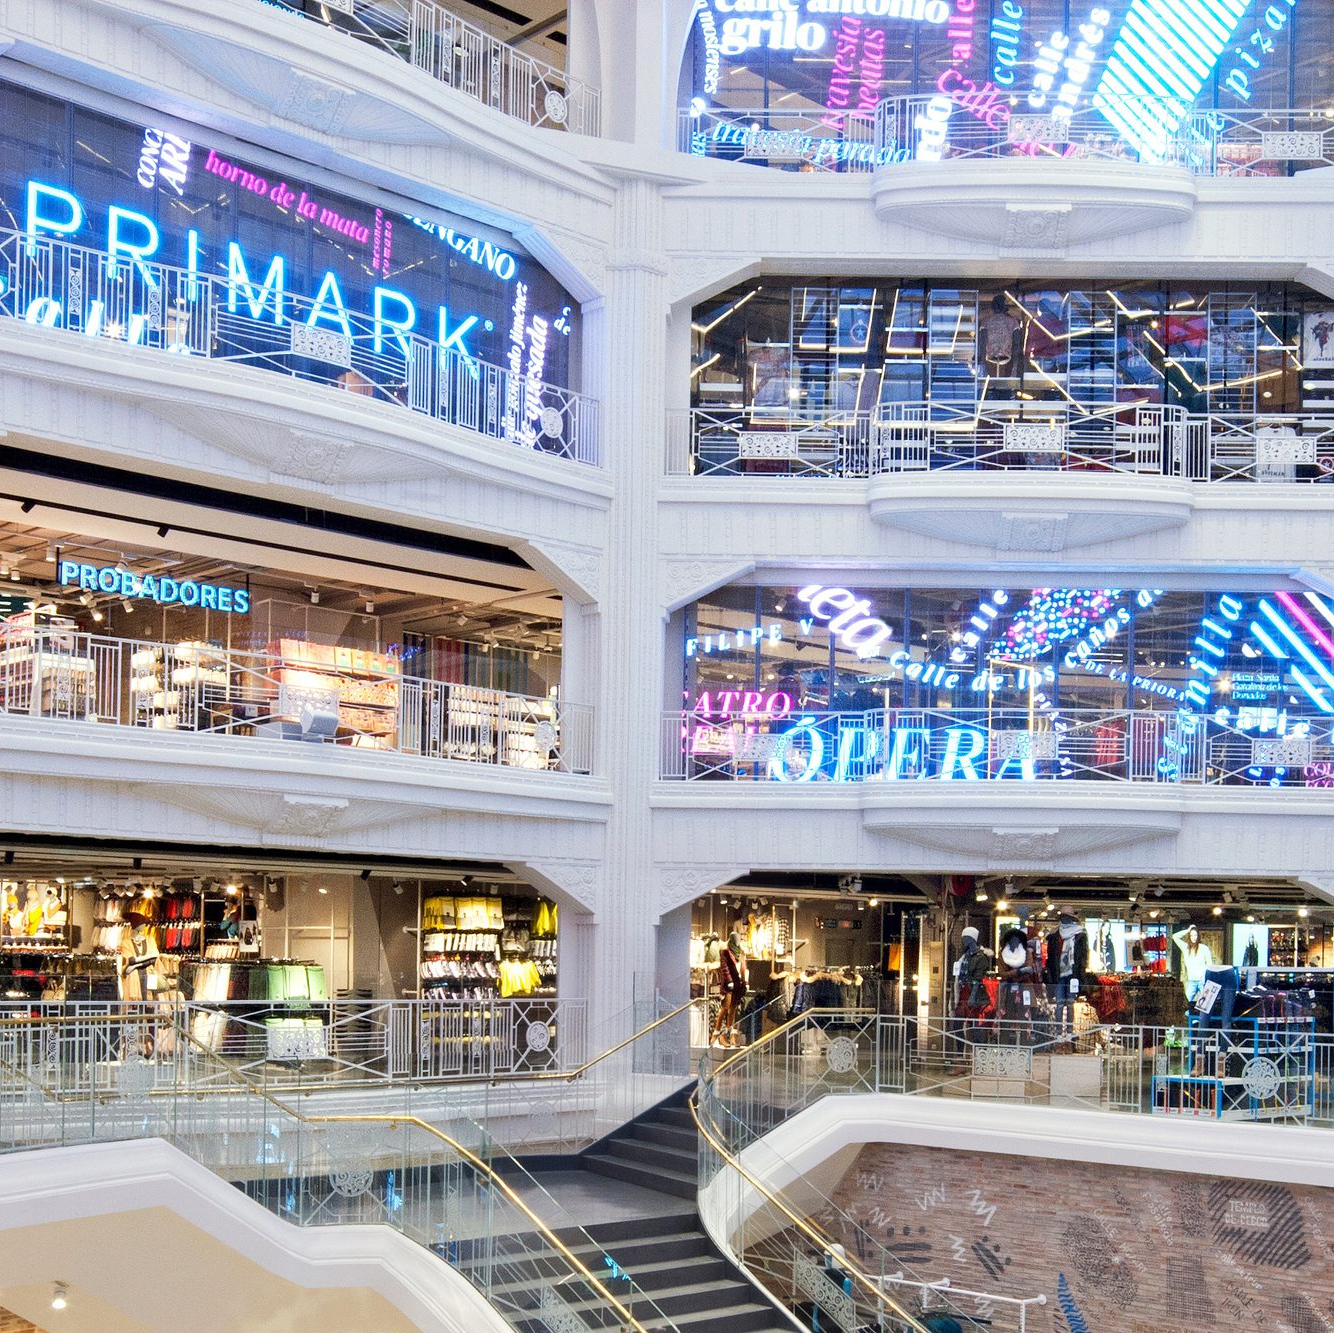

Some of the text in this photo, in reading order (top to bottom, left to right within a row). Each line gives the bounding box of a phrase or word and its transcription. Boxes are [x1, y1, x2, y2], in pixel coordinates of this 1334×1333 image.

[722, 12, 827, 56] grilo
[204, 149, 371, 244] horno de la mata
[60, 561, 250, 614] PROBADORES
[951, 588, 1010, 663] calle
[889, 651, 960, 691] Calle
[972, 669, 1005, 692] de
[768, 714, 1037, 783] ÓPERA
